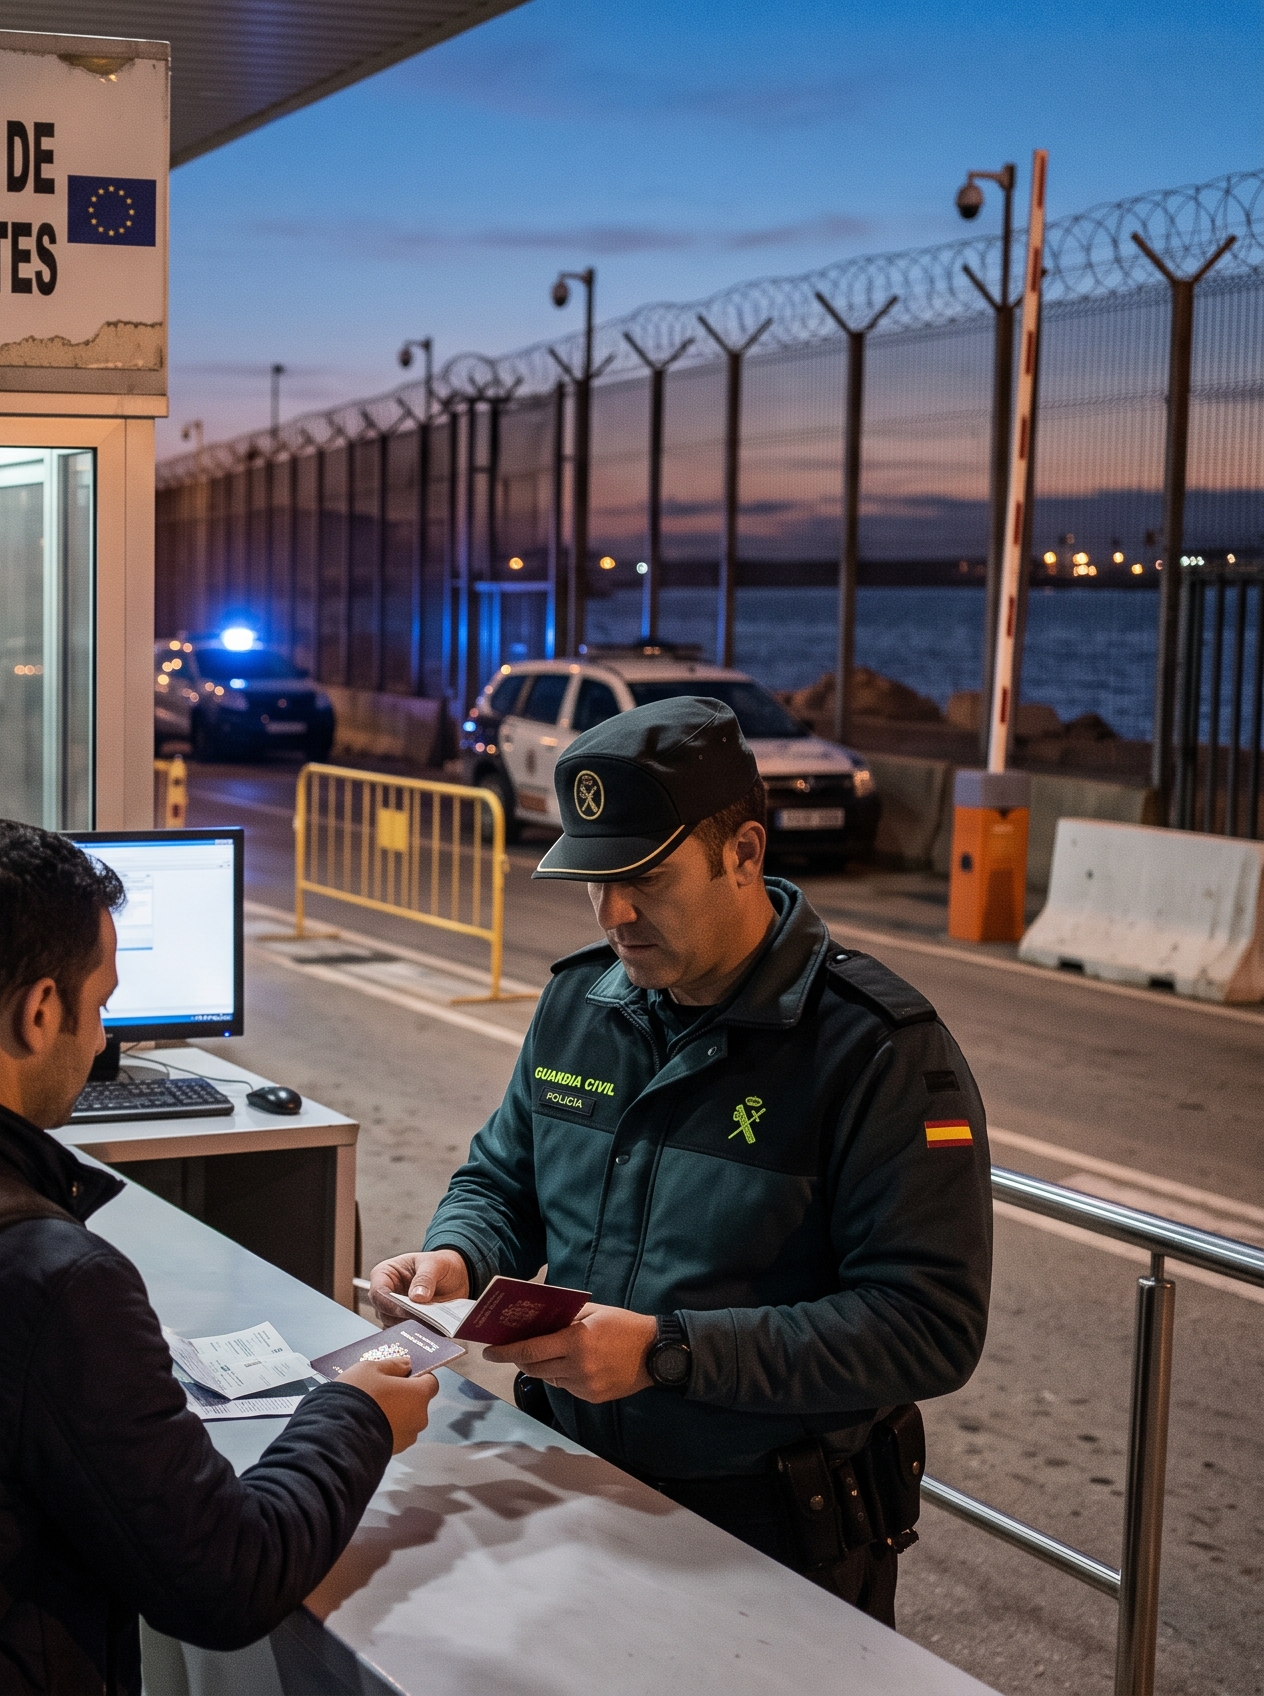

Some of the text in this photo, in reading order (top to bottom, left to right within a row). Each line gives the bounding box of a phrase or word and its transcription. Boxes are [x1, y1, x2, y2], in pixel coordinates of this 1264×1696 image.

[6, 120, 55, 195] DE
[584, 1078, 615, 1096] CIVIL
[546, 1092, 583, 1108] POLICIA
